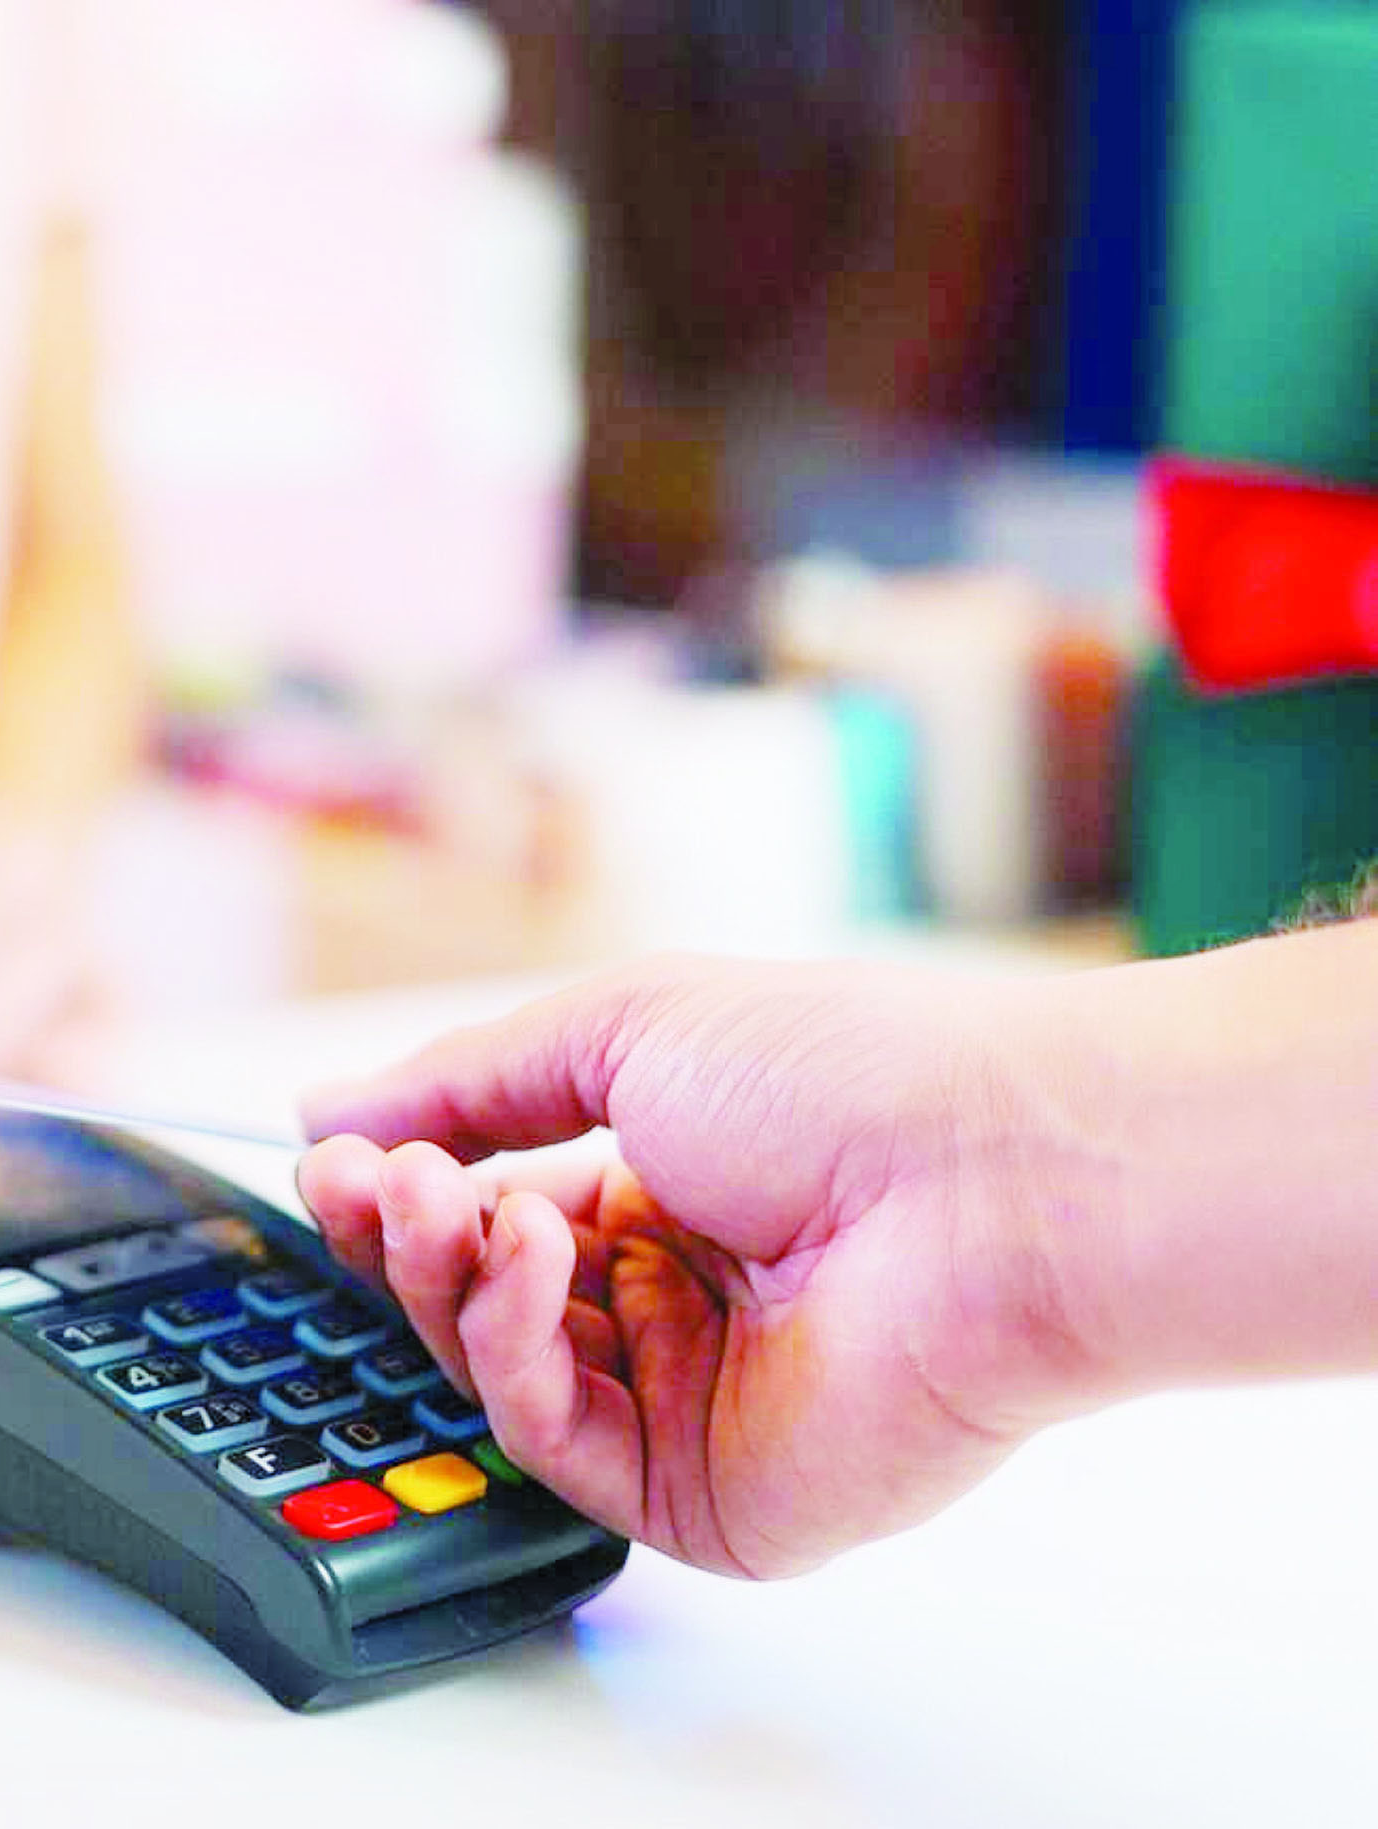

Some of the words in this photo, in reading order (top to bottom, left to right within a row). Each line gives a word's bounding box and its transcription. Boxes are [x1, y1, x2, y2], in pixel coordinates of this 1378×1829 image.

[63, 1326, 94, 1345] 1
[127, 1366, 160, 1387] 4
[181, 1405, 214, 1430] 7
[245, 1446, 278, 1473] F
